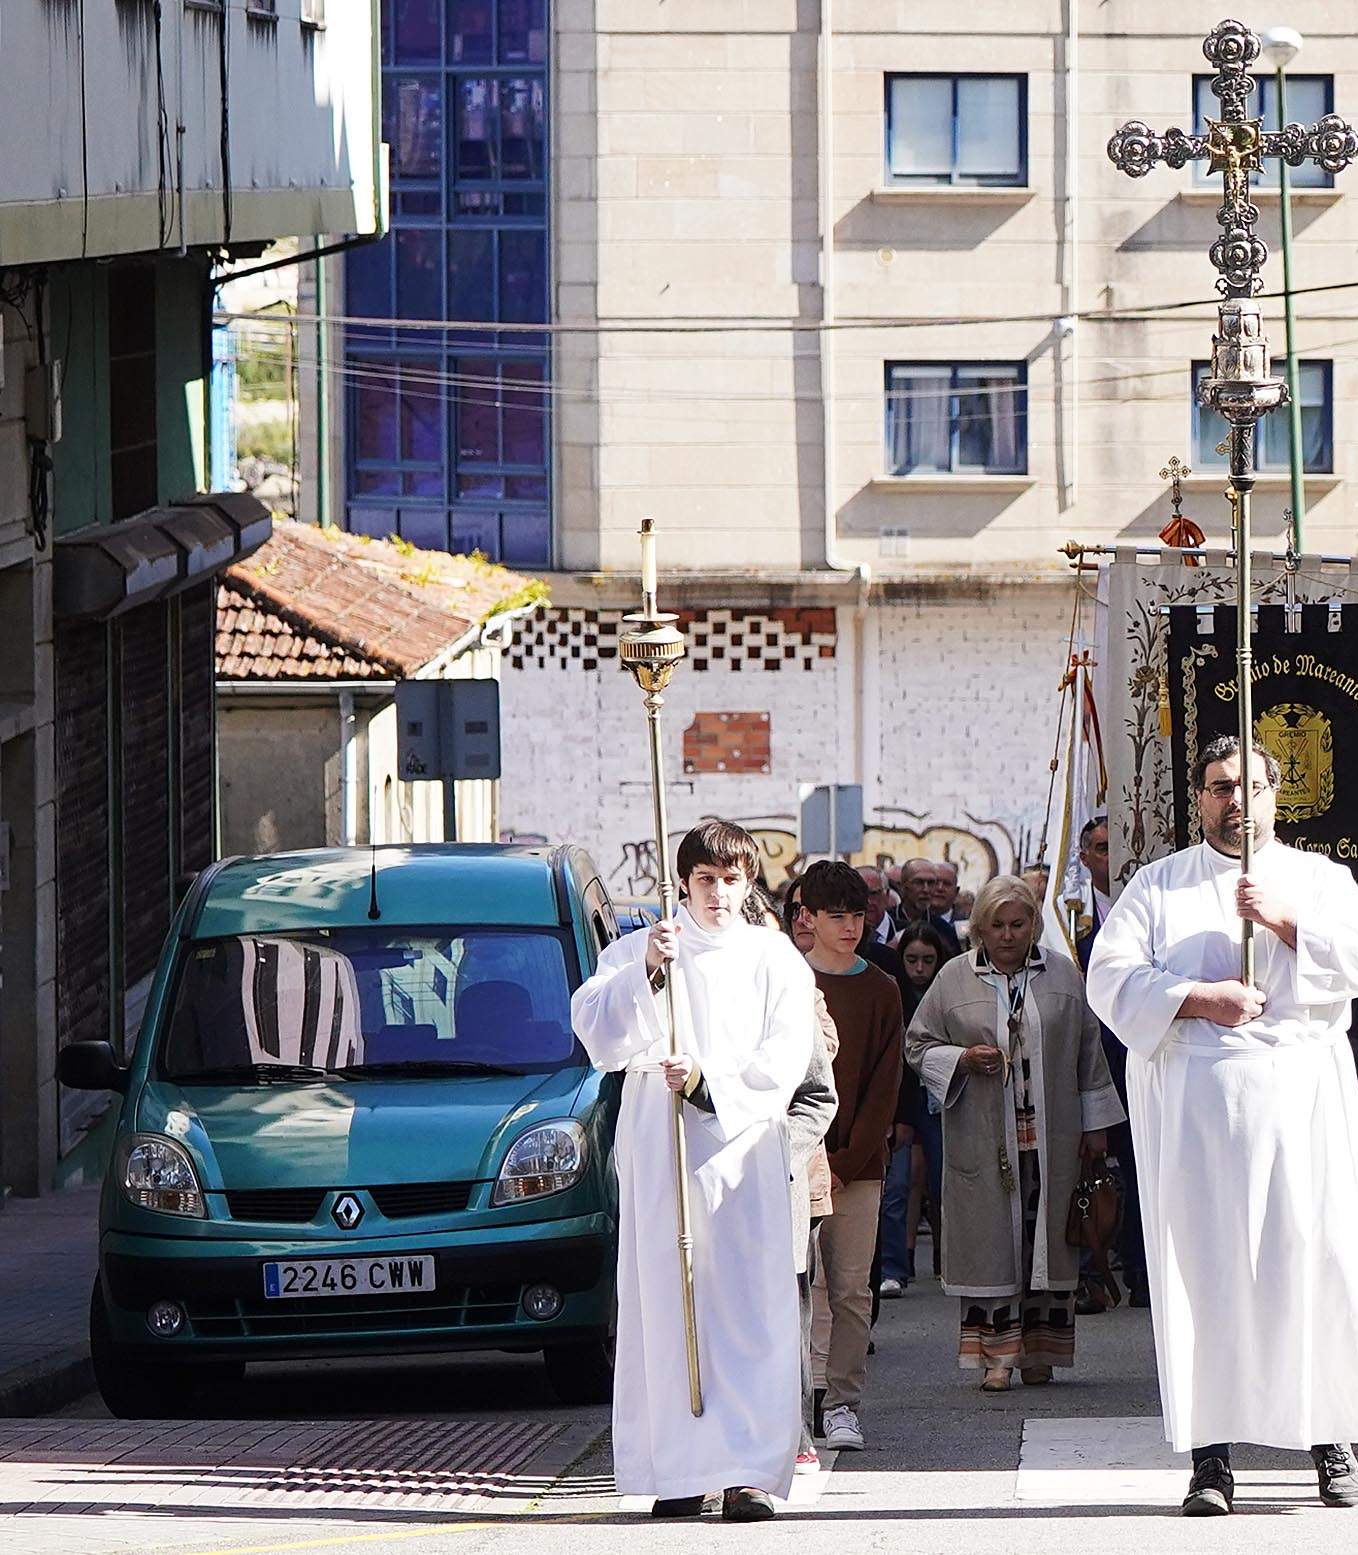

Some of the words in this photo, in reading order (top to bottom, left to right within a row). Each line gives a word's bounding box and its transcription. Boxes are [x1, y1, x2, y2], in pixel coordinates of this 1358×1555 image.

[1214, 659, 1270, 702] Grio
[1273, 654, 1290, 675] de
[282, 1264, 358, 1293] 2246
[368, 1261, 423, 1289] CWW
